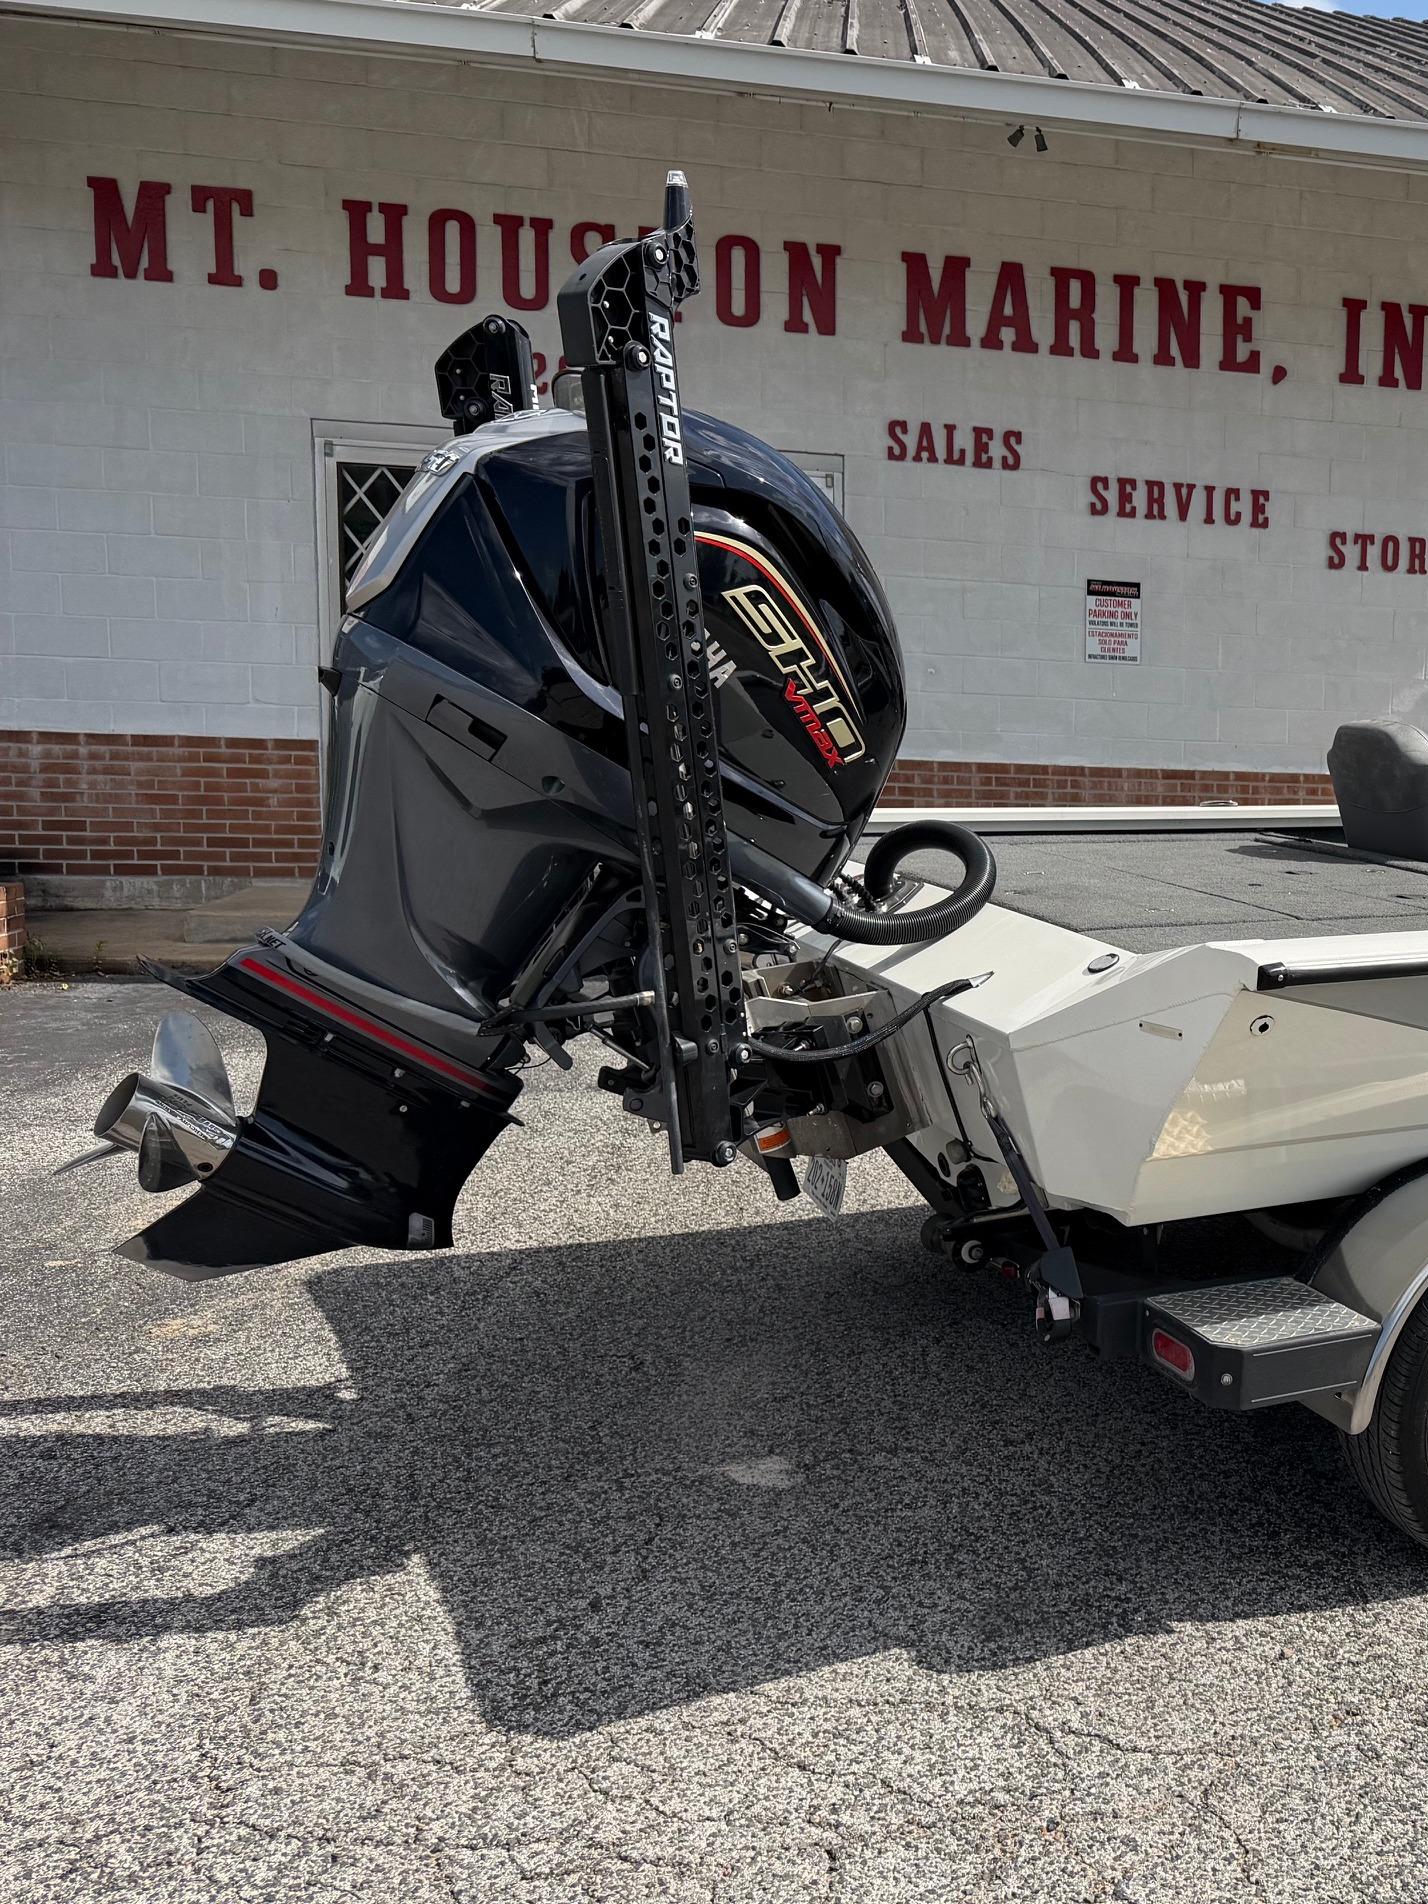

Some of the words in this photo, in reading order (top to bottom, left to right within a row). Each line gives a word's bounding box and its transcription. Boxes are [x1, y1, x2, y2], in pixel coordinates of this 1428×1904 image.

[87, 176, 279, 290] MT.
[342, 199, 842, 337] HOUON
[900, 251, 1288, 386] MARINE,
[649, 312, 684, 466] RAPTOR
[887, 419, 1023, 471] SALES
[1090, 475, 1270, 529] SERVICE
[1088, 609, 1118, 620] PARKING
[1120, 610, 1138, 621] ONLY
[1095, 598, 1132, 609] CUSTOMER
[721, 584, 866, 763] SHO
